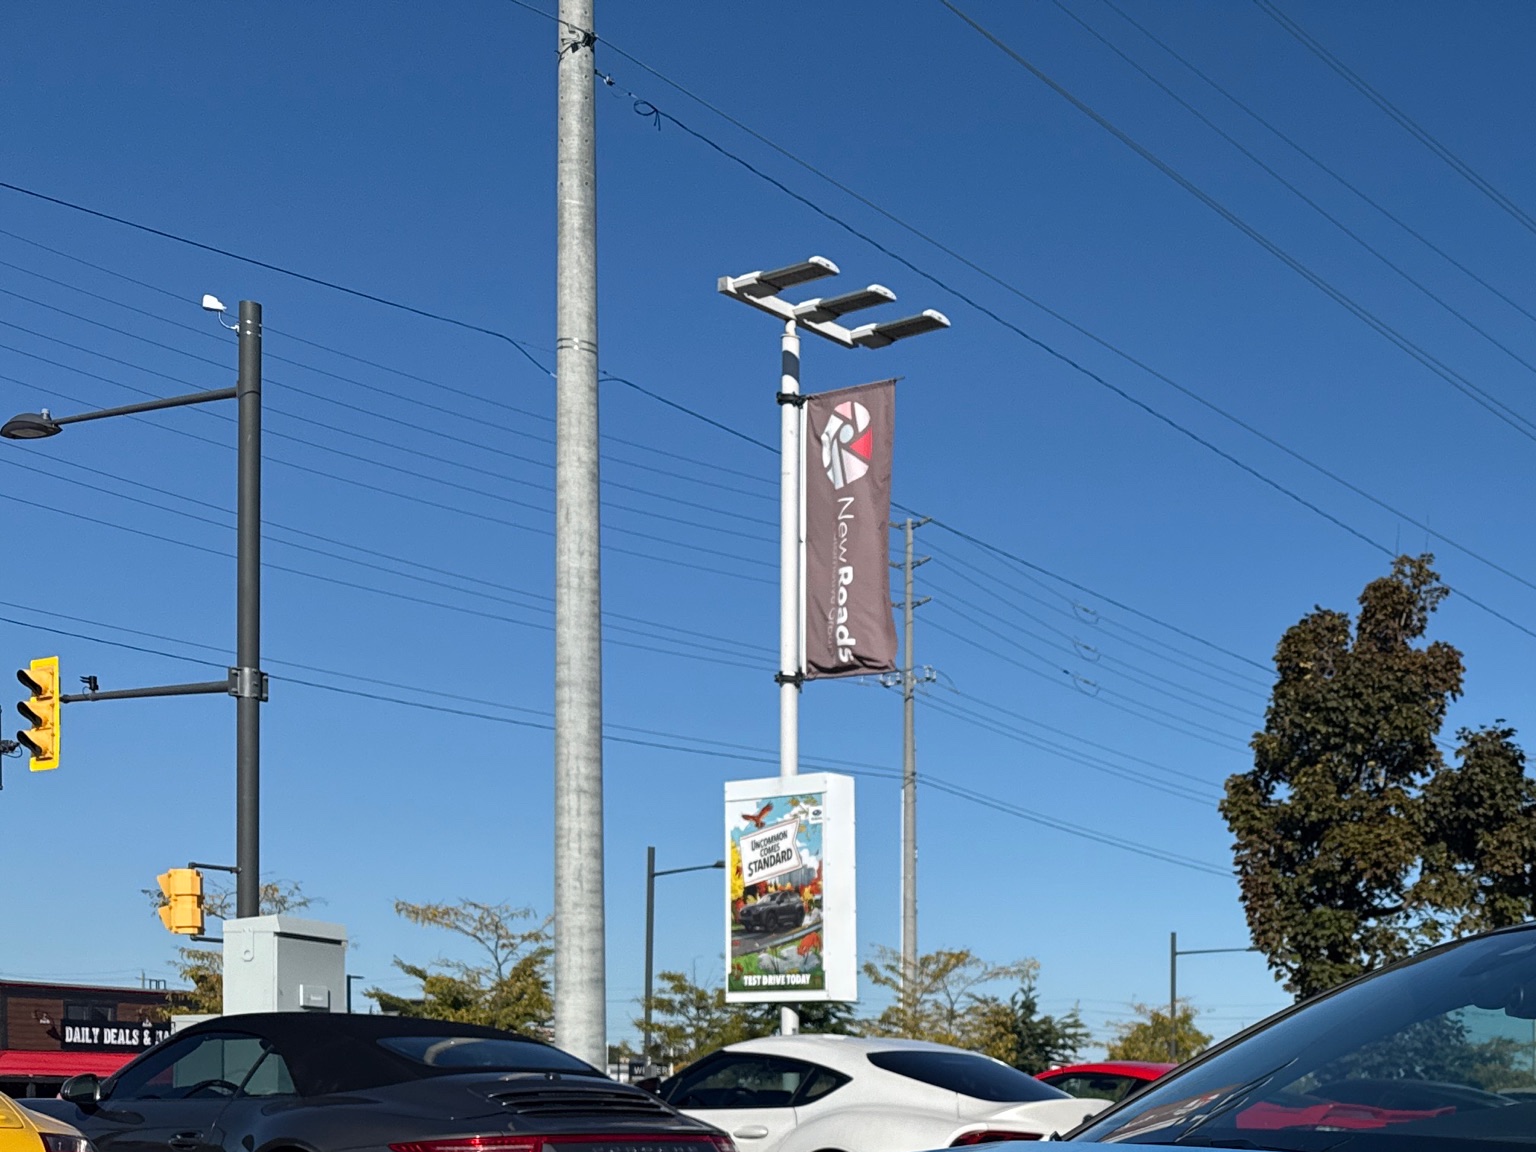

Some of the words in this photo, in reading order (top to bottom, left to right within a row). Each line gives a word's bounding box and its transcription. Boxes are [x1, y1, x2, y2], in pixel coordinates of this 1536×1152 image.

[760, 843, 780, 857] COMES
[748, 848, 793, 877] STANDARD
[743, 975, 761, 986] TEST
[762, 974, 786, 986] DRIVE
[786, 974, 811, 985] TODAY
[65, 1026, 99, 1044] DAILY
[103, 1028, 139, 1045] DEALS
[143, 1029, 151, 1046] &
